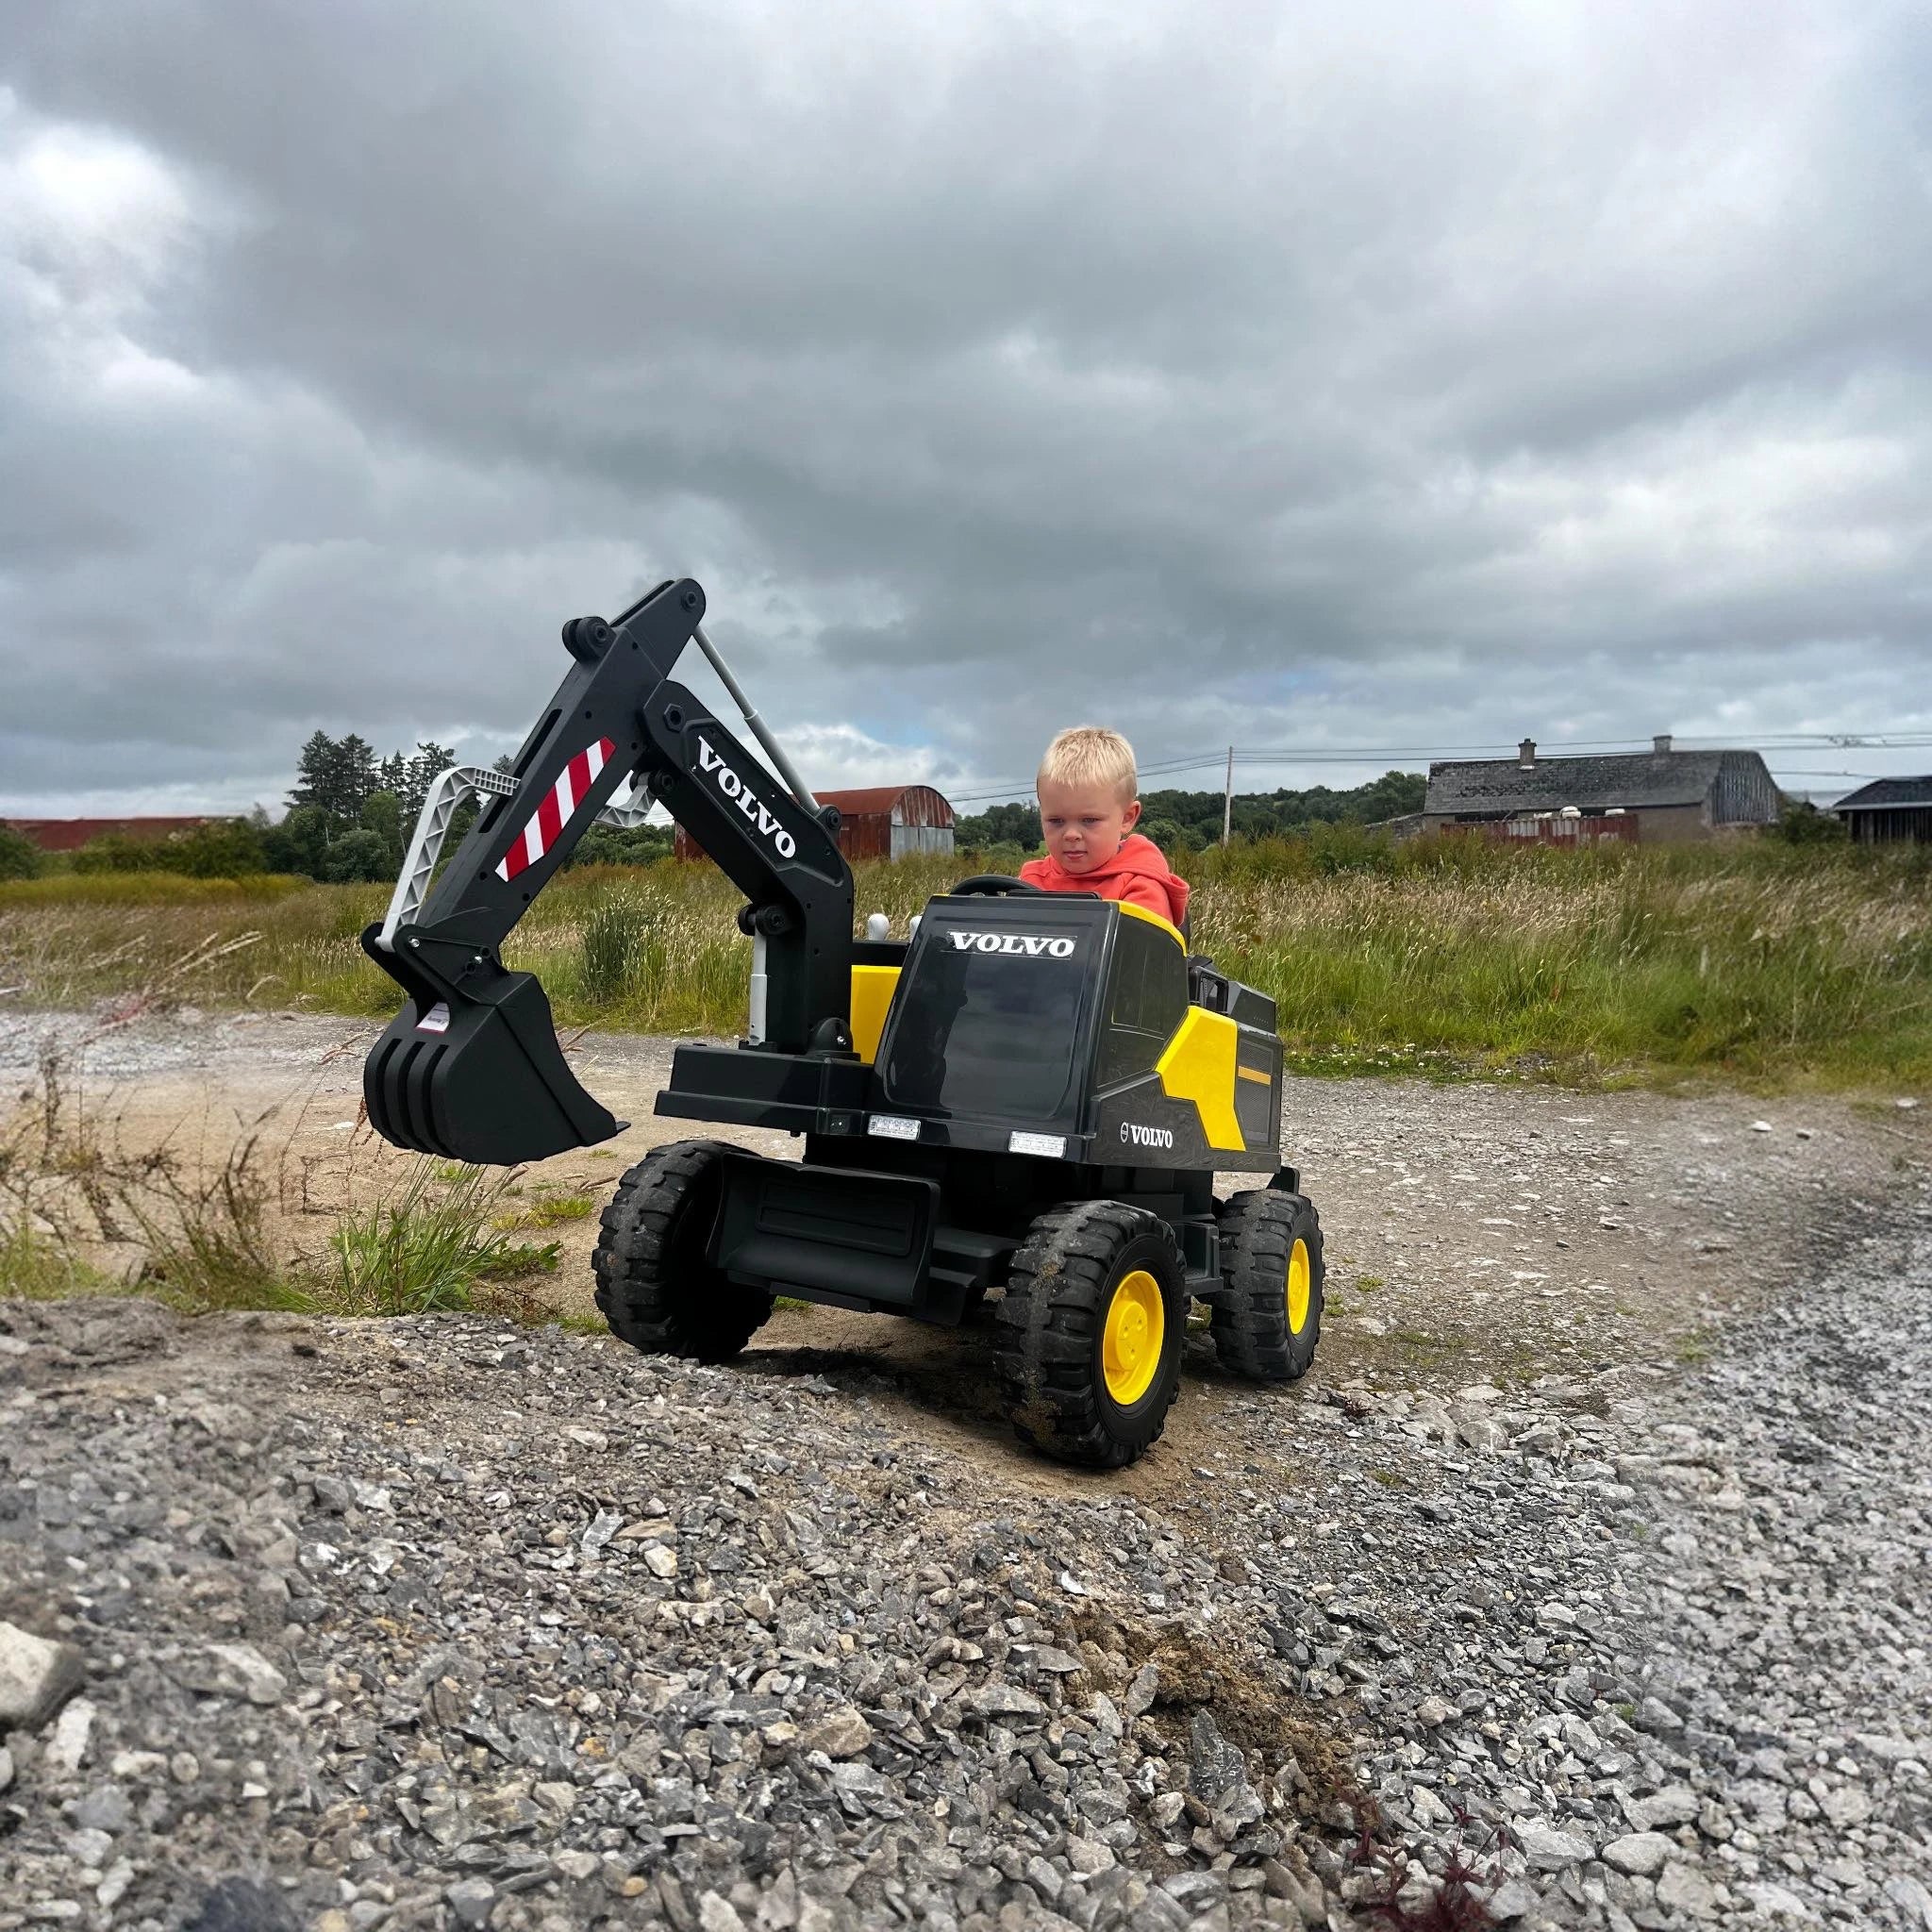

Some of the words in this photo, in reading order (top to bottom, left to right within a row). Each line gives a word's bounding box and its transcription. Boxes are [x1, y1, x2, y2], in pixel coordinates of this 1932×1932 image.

[698, 735, 796, 858] VOLVO
[949, 931, 1074, 958] VOLVO
[1130, 1124, 1174, 1149] VOLVO
